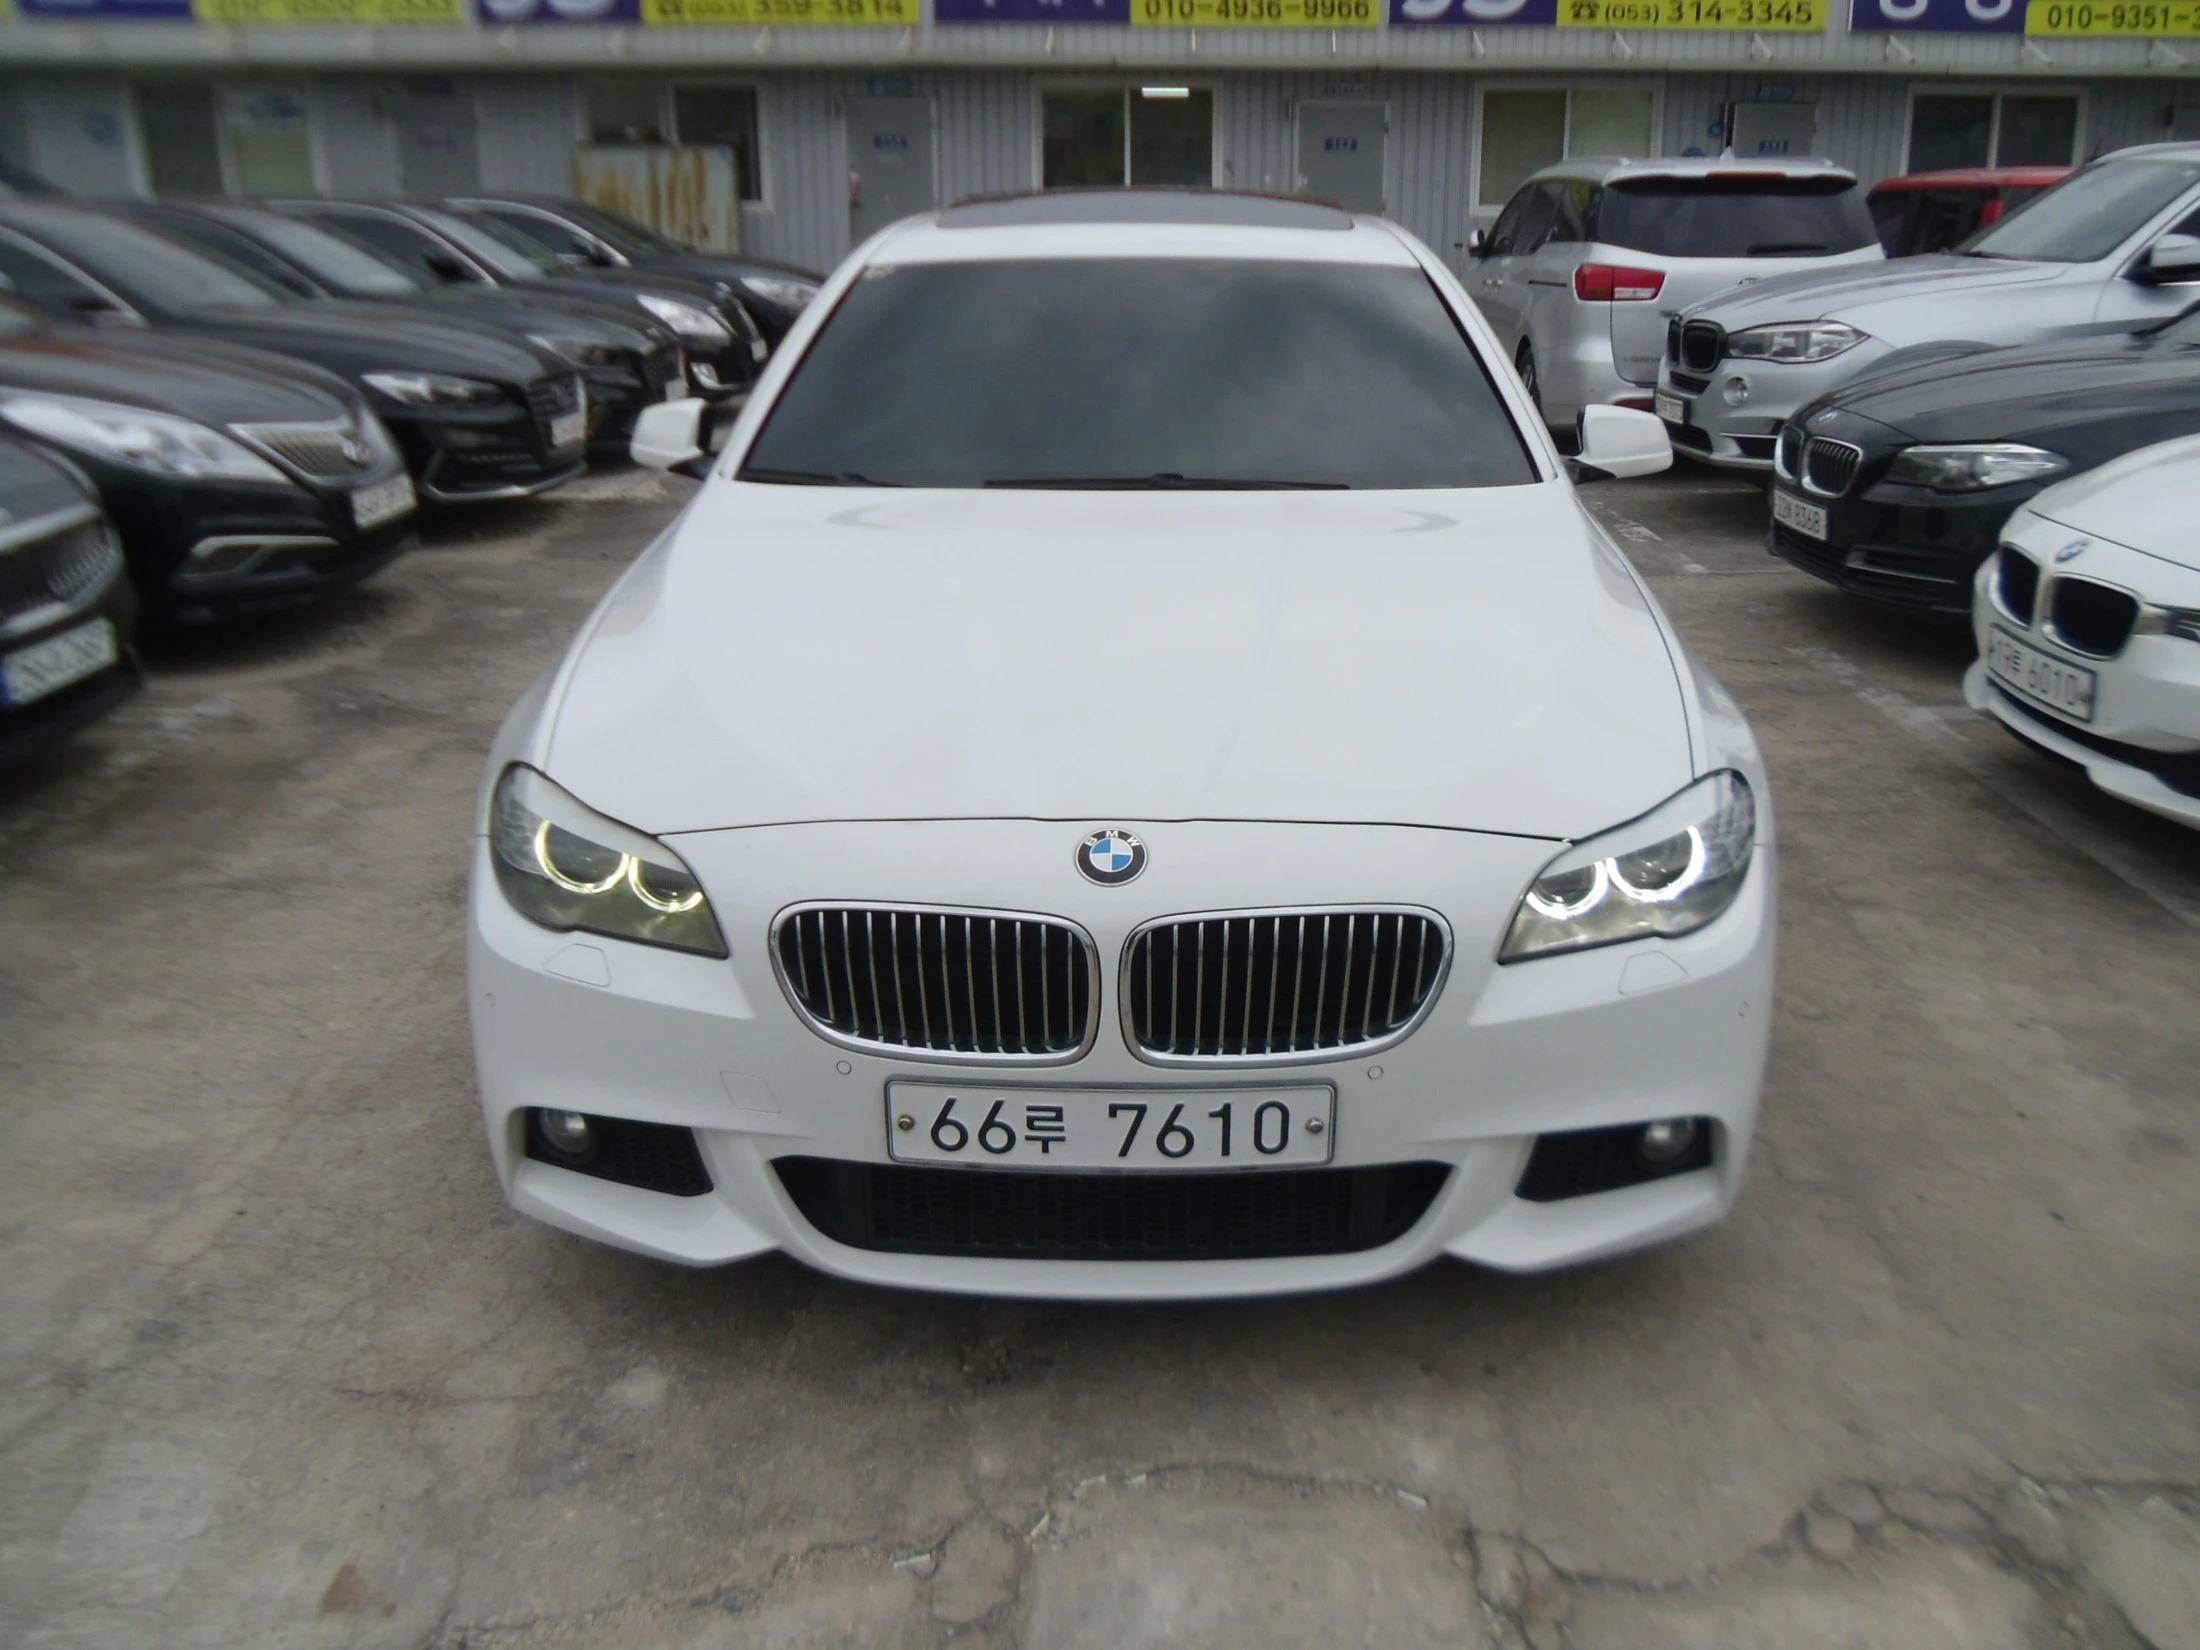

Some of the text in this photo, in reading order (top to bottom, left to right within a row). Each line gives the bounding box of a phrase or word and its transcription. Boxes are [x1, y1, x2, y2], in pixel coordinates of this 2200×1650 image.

[1145, 0, 1369, 19] 010-4936-9966
[1084, 829, 1141, 847] BMW
[930, 1097, 1291, 1158] 66루 7610
